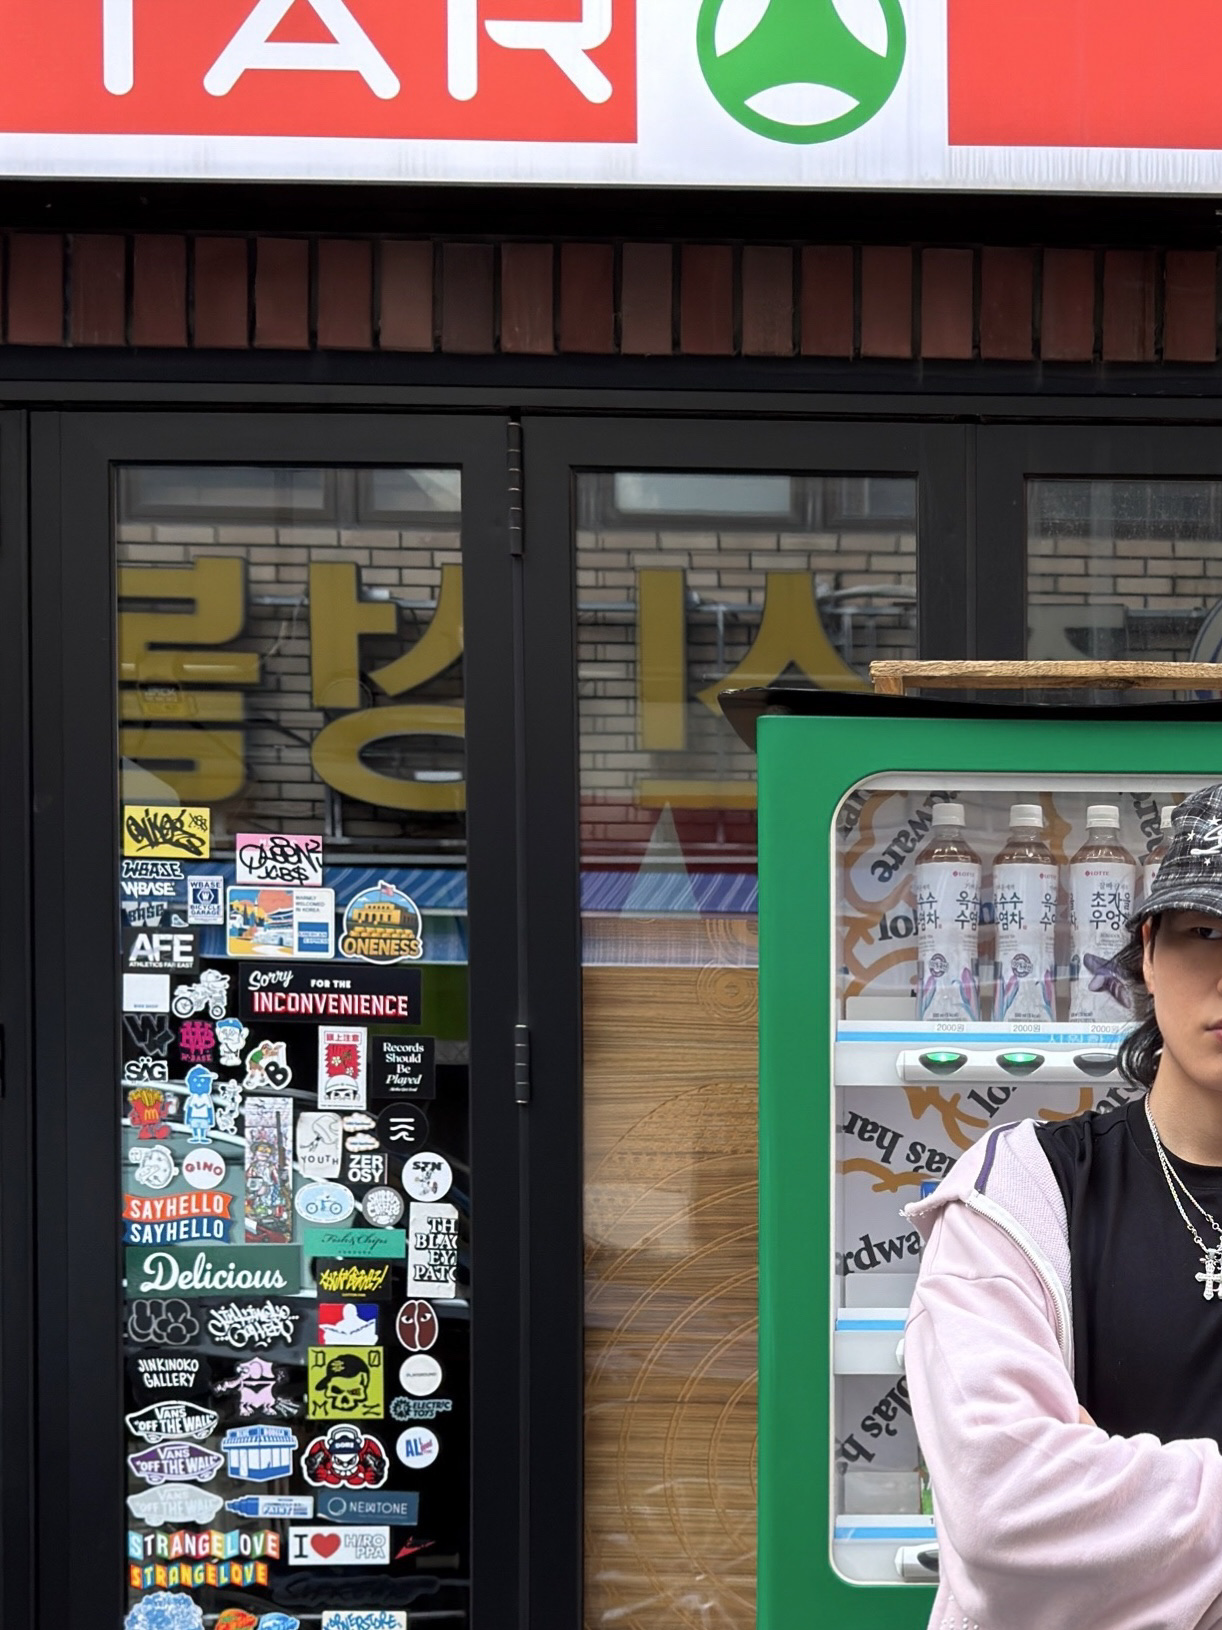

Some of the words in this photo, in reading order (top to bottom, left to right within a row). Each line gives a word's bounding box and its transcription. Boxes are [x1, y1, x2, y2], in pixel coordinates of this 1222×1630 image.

[129, 934, 194, 961] AFE
[344, 938, 421, 956] ONENESS
[248, 970, 293, 990] Sorry
[311, 979, 330, 988] FOR
[333, 979, 351, 989] THE
[253, 992, 409, 1016] INCONVENIENCE
[937, 1024, 964, 1032] 2000원
[1013, 1024, 1040, 1033] 2000원
[383, 1042, 424, 1052] Records
[386, 1053, 422, 1063] Should
[397, 1064, 411, 1073] Be
[386, 1074, 422, 1086] Played
[301, 1155, 339, 1166] YOUTH
[350, 1155, 383, 1168] ZER
[185, 1162, 223, 1176] GINO
[348, 1169, 383, 1182] OSY
[130, 1194, 223, 1219] SAYHELLO
[130, 1219, 223, 1243] SAYHELLO
[427, 1217, 458, 1233] TH
[428, 1250, 457, 1265] EY
[140, 1252, 287, 1292] Delicious
[138, 1358, 199, 1372] JINKINOKO
[143, 1373, 195, 1388] GALLERY
[154, 1405, 187, 1420] VANS
[412, 1401, 451, 1410] ELECTRIC
[160, 1419, 181, 1433] THE
[157, 1446, 190, 1459] VANS
[161, 1459, 184, 1474] THE
[130, 1533, 279, 1556] STRANGELOVE
[294, 1534, 308, 1558] I
[131, 1562, 267, 1586] STRANGELOVE
